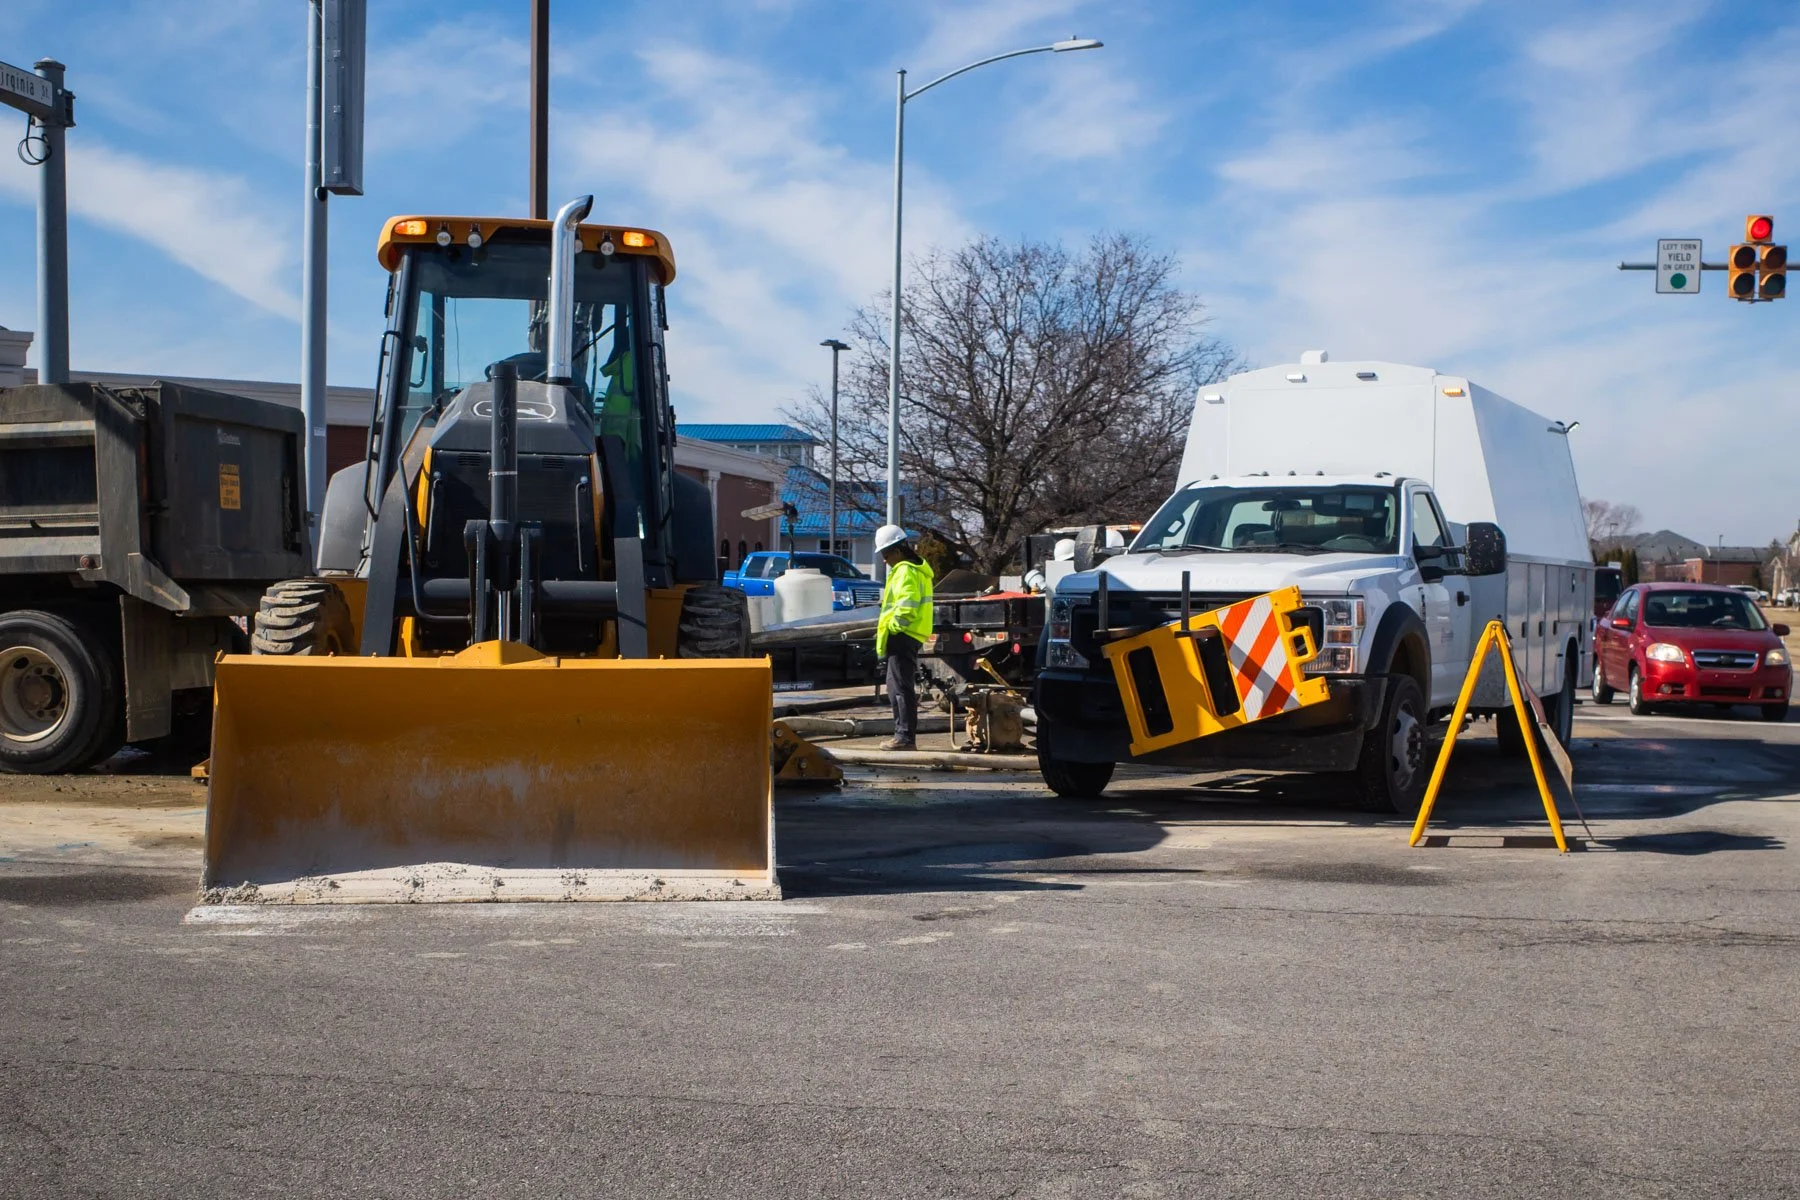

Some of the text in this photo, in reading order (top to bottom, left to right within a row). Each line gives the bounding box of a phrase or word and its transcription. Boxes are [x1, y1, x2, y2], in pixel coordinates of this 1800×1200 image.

[0, 67, 35, 96] irginia
[1668, 252, 1692, 262] YIELD
[1662, 263, 1695, 271] ON GREEN
